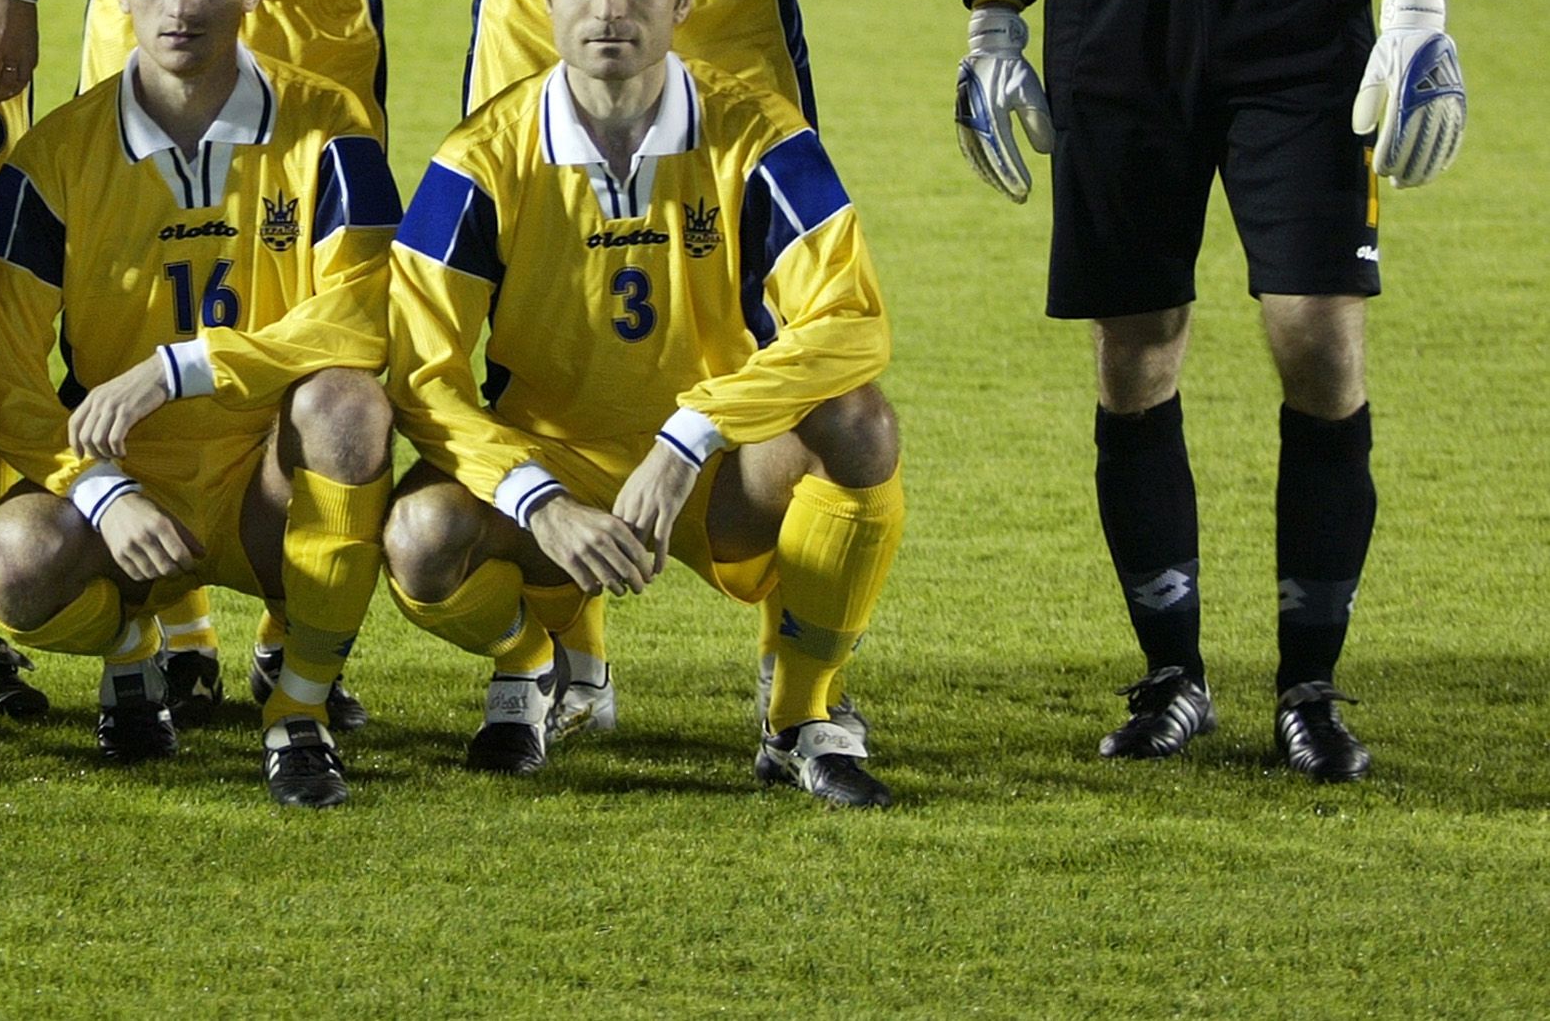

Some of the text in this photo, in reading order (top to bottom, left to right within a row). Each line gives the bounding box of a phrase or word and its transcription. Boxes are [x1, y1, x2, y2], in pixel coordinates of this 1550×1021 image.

[176, 220, 238, 240] lotto
[604, 229, 669, 248] lotto
[164, 259, 241, 335] 16
[610, 266, 658, 344] 3
